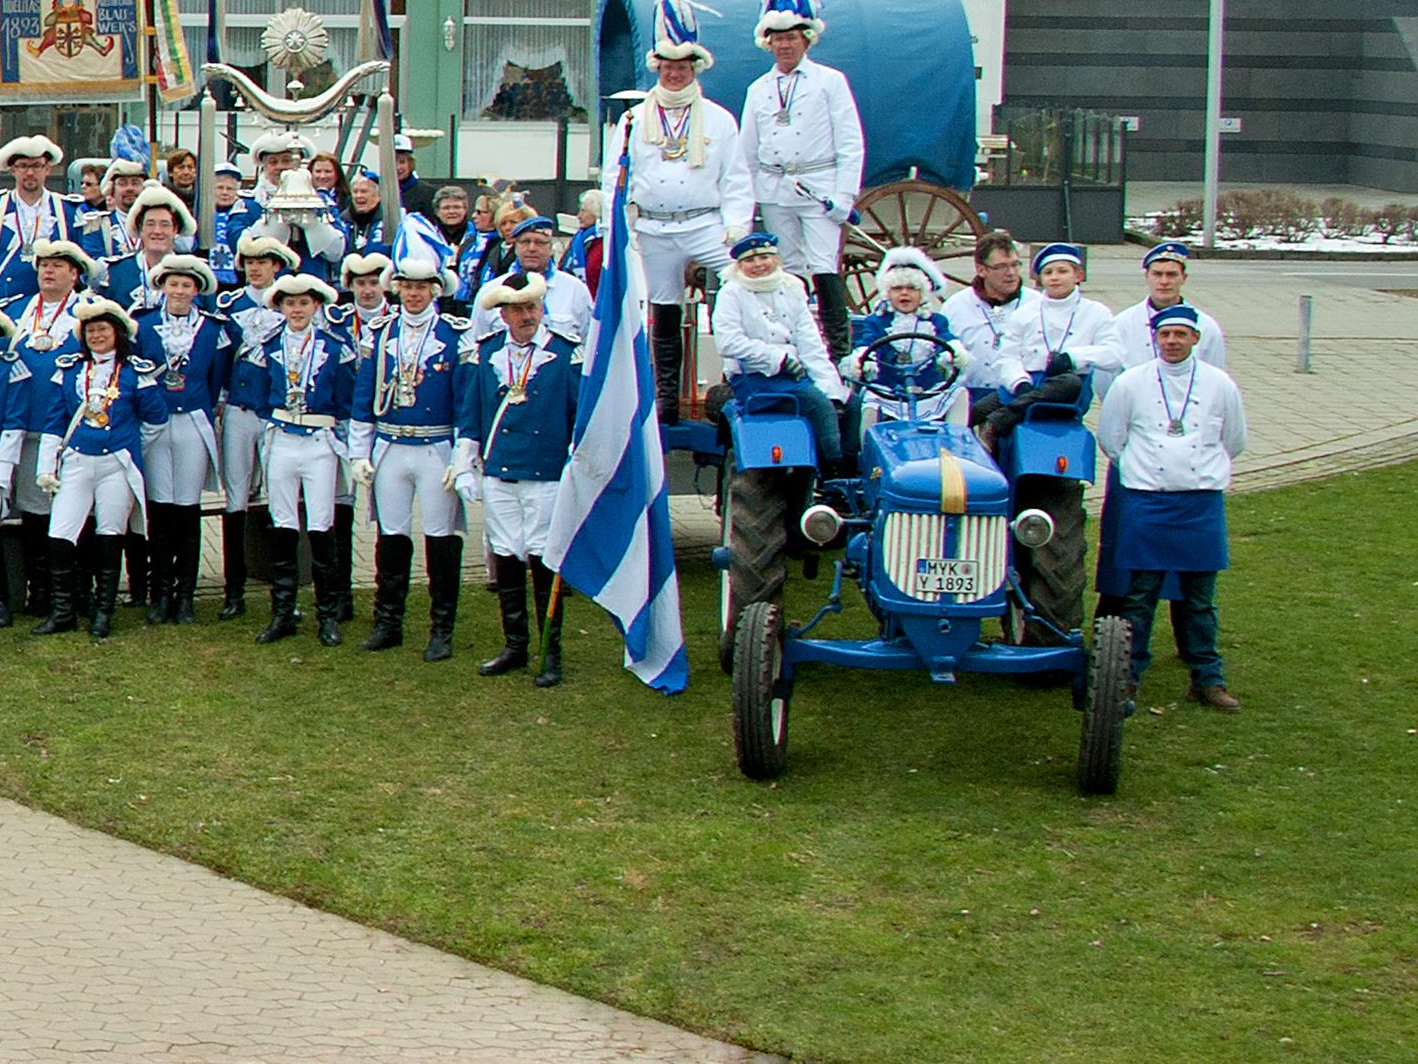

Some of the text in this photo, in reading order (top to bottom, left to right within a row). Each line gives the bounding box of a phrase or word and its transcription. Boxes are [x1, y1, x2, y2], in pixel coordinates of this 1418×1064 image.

[928, 562, 958, 575] MYK
[920, 577, 973, 591] Y 1893
